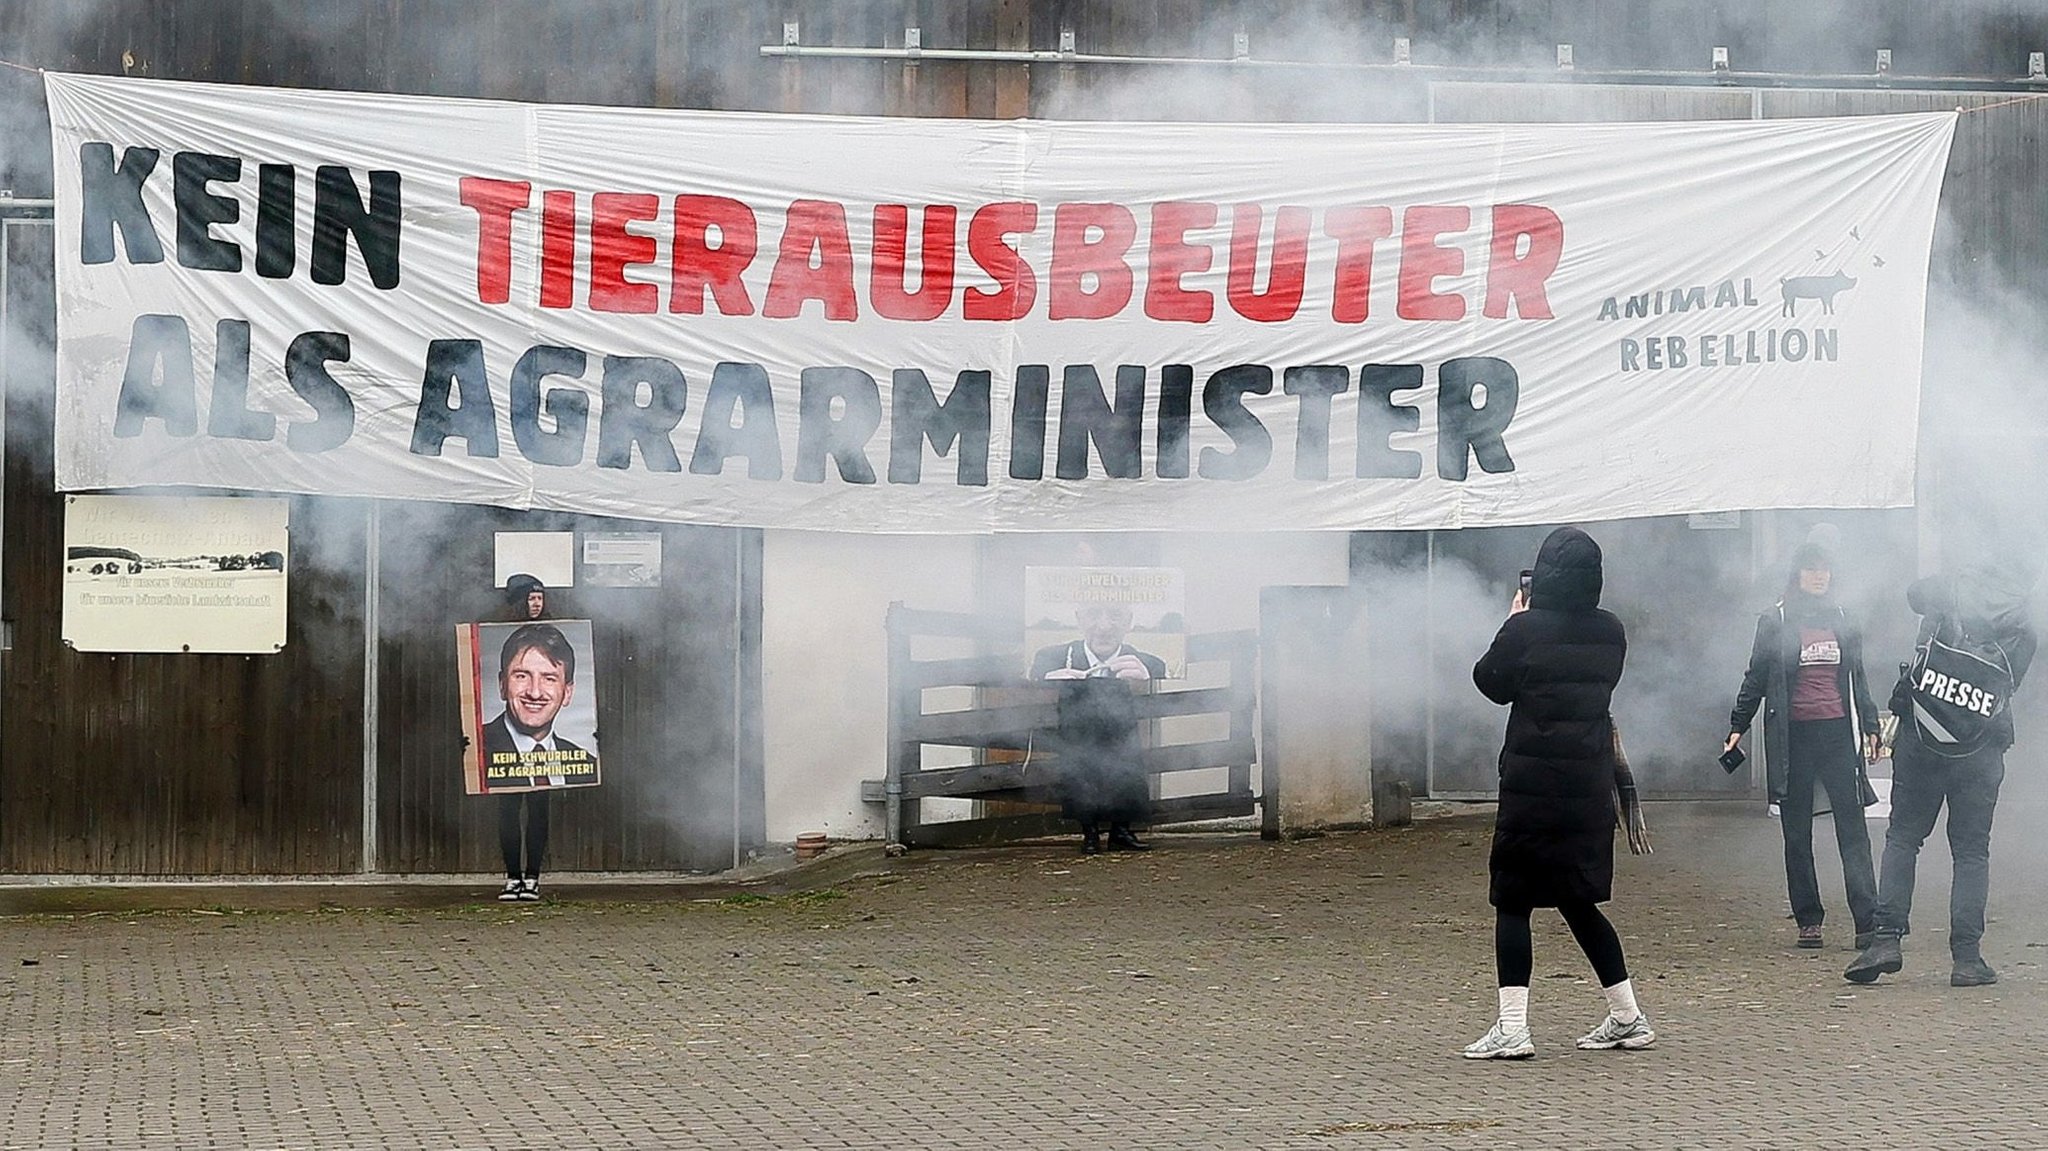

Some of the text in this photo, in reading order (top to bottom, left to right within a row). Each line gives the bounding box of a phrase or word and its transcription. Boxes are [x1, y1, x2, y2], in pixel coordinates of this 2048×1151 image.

[79, 141, 1565, 323] KEIN TIERAUSBEUTER
[1596, 278, 1758, 321] ANIMAL
[1620, 328, 1838, 372] REBELLION
[112, 314, 1520, 487] ALS AGRARMINISTER
[1919, 668, 1994, 717] PRESSE
[487, 763, 594, 778] ALS AGRARMINISTER!
[492, 749, 587, 764] KEIN SCHWURBLER
